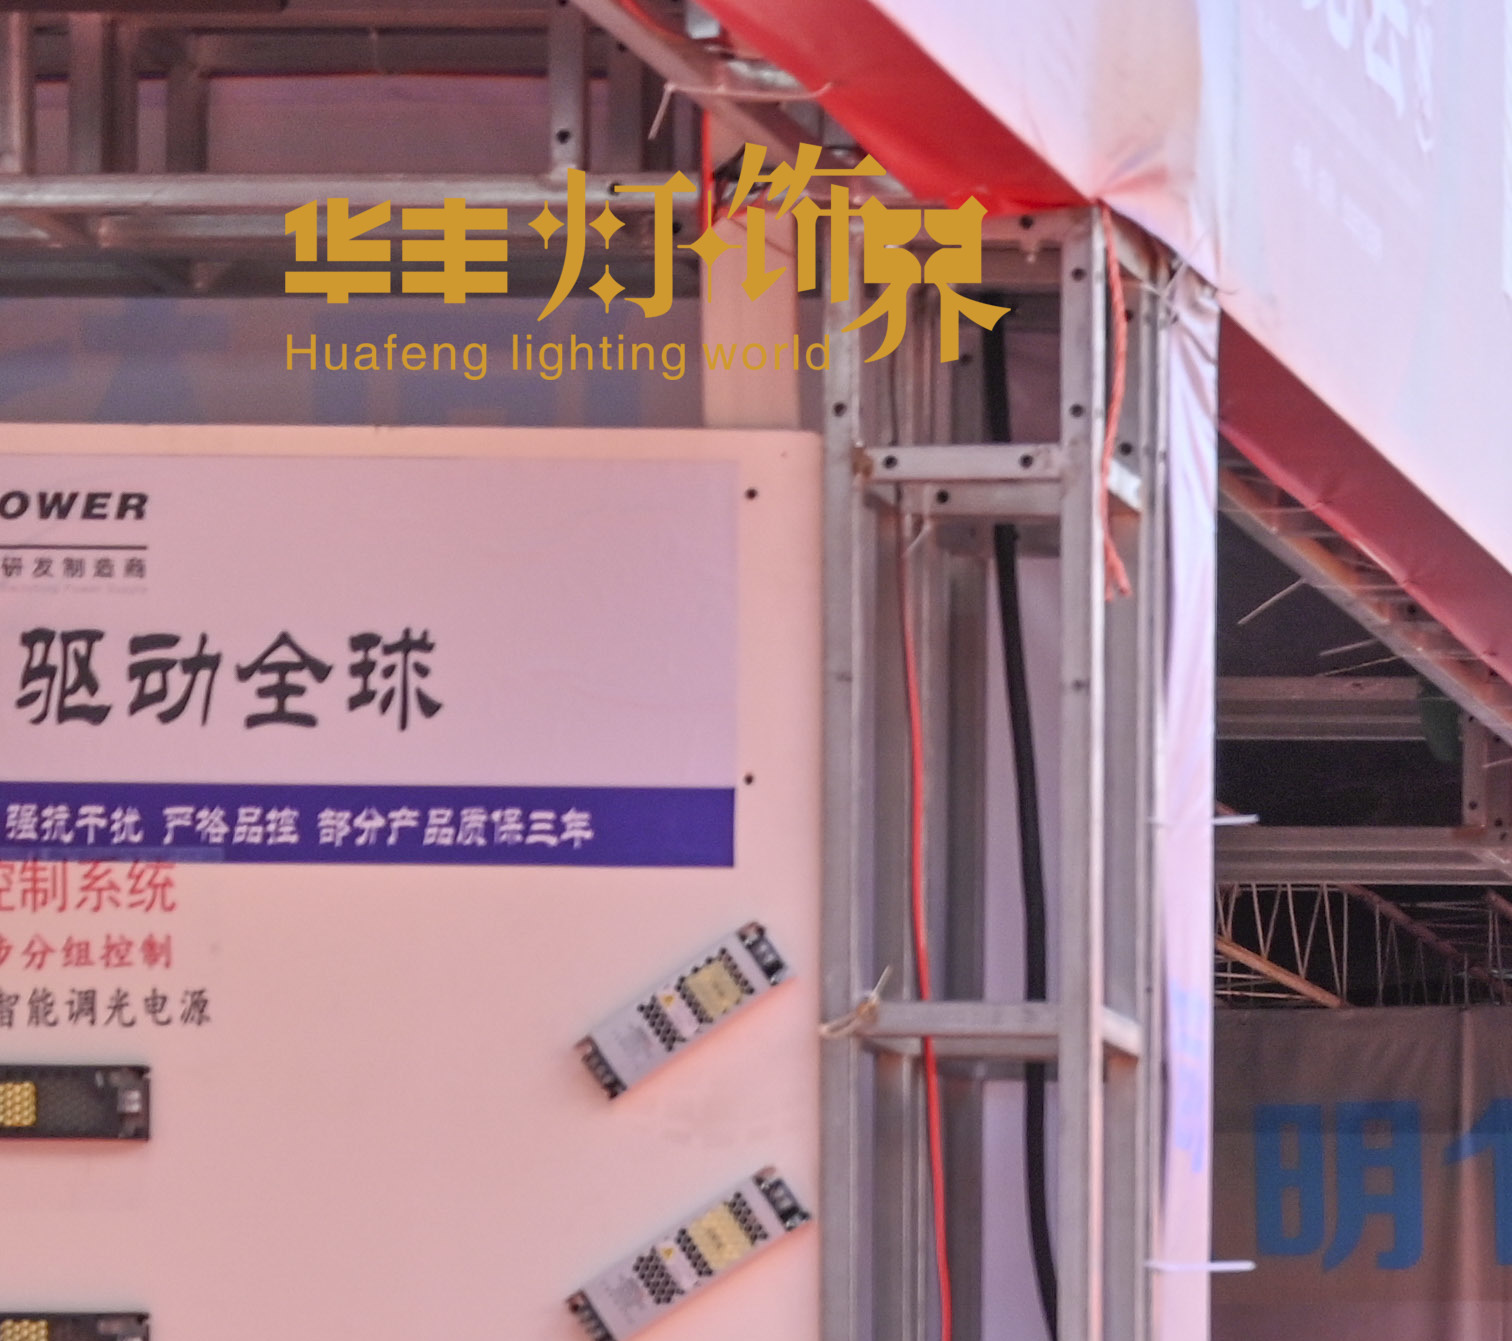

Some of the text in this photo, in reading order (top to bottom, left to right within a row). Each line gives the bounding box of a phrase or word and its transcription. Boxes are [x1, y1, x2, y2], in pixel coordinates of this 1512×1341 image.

[0, 556, 148, 580] 研发制造商
[17, 627, 443, 731] 驱动全球
[6, 804, 594, 848] 强抗干扰 严格品控 部分产品质保三年
